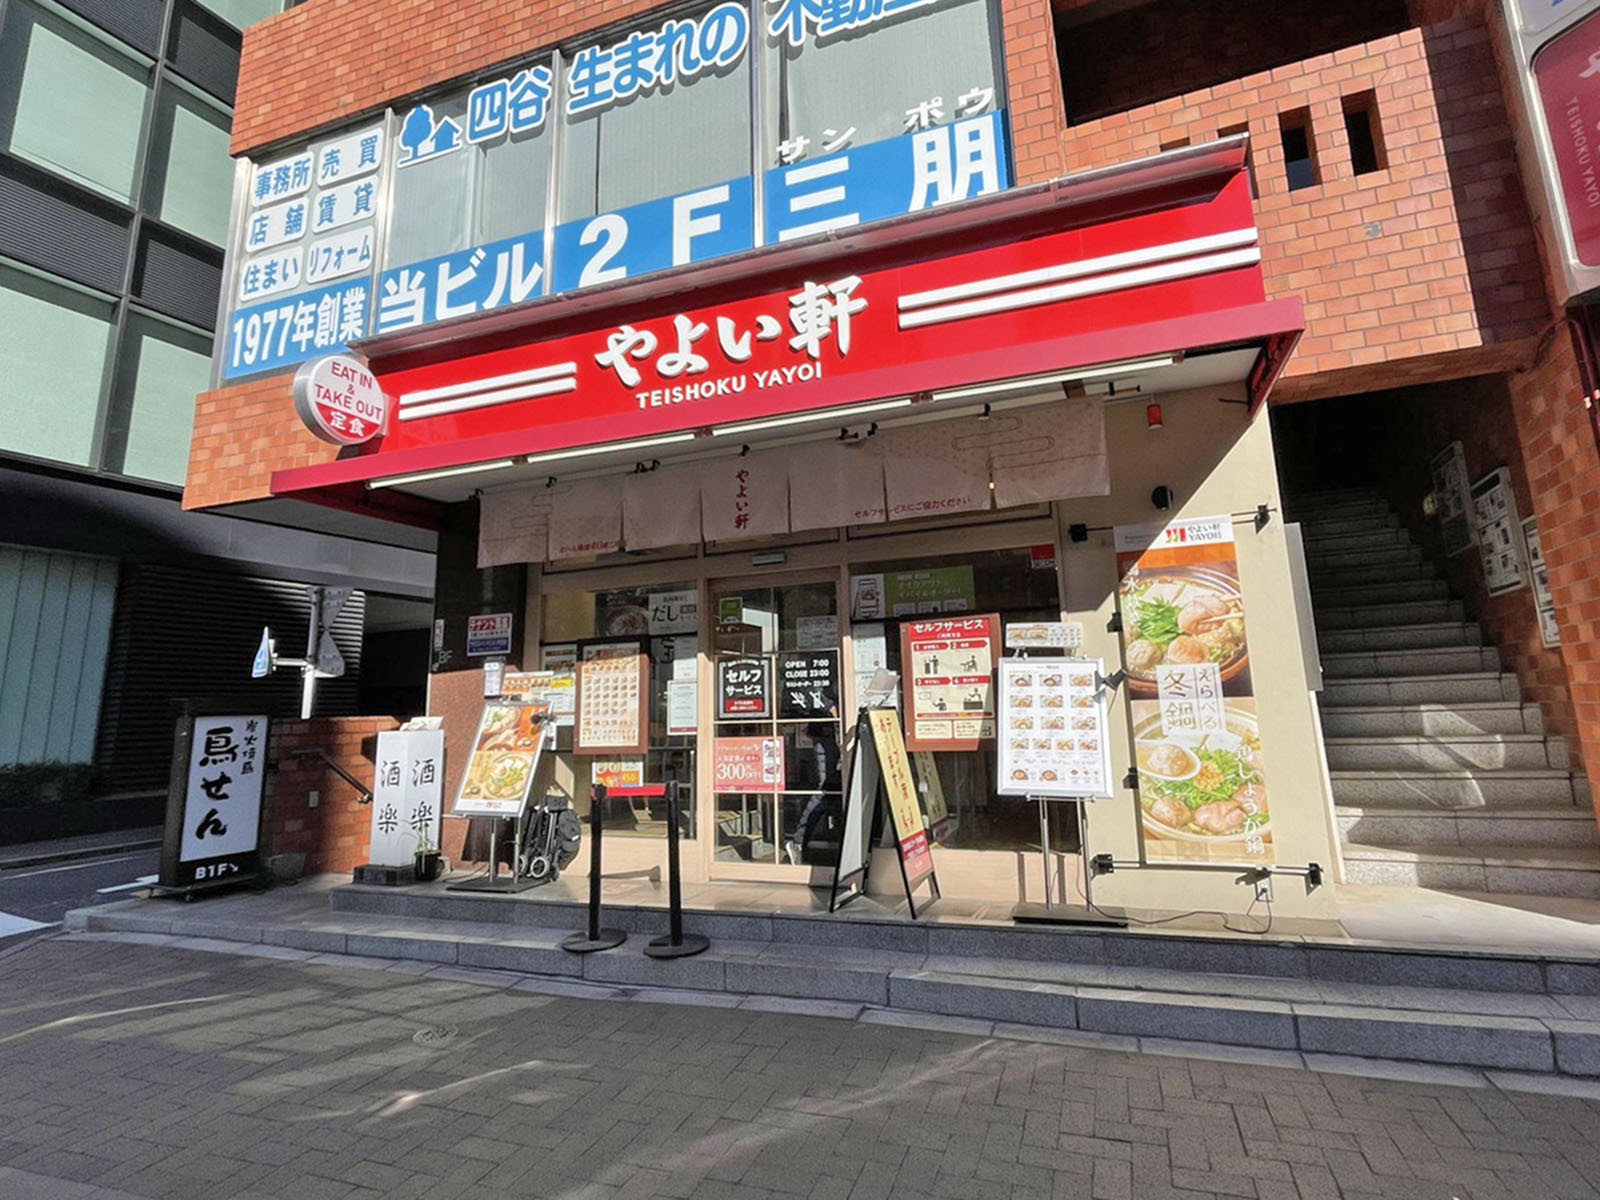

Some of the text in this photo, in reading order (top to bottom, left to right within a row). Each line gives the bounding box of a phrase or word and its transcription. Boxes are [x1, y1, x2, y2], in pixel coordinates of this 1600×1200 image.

[466, 66, 552, 144] 四谷
[568, 1, 748, 114] 生まれの
[1566, 96, 1591, 164] TEISHOKU
[321, 134, 379, 178] 売買
[255, 159, 310, 200] 事務所
[317, 182, 374, 227] 賃貸
[250, 205, 304, 246] 店舗
[308, 235, 371, 276] リフォーム
[242, 257, 299, 296] 住まい
[378, 242, 544, 334] 当ビル
[231, 286, 366, 368] 1977年創業
[594, 275, 868, 388] やよい軒
[331, 361, 373, 390] EAT IN
[346, 383, 355, 395] &
[636, 361, 823, 409] TEISHOKU YAYOI
[315, 383, 382, 420] TAKE OUT
[330, 411, 365, 438] 定食
[735, 469, 749, 530] やよい軒
[914, 619, 984, 633] セルフサービス
[726, 669, 762, 683] セルフ
[785, 660, 807, 669] OPEN
[785, 670, 808, 679] CLOSE
[725, 685, 763, 696] サービス
[1198, 668, 1217, 730] えらべる
[378, 760, 400, 835] 酒楽
[411, 759, 436, 833] 酒楽
